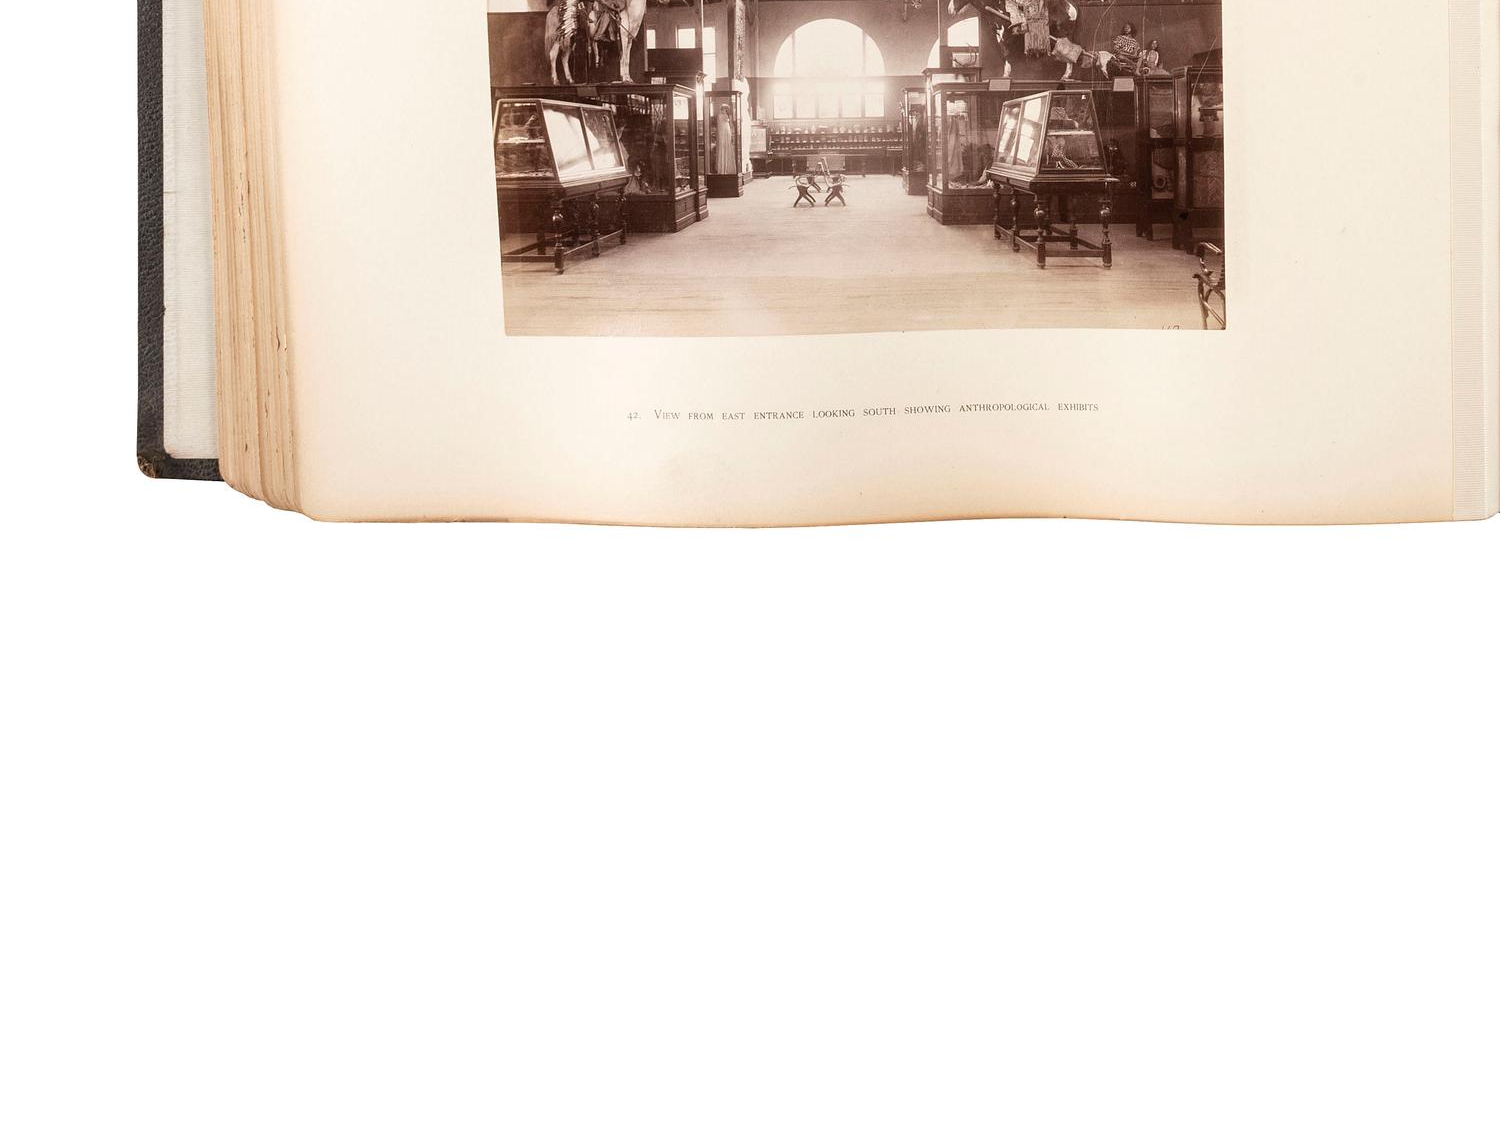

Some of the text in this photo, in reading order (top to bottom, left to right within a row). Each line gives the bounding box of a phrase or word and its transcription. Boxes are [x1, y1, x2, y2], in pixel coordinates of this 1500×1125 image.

[653, 408, 681, 420] VIEW
[688, 411, 714, 421] FROM
[721, 411, 746, 421] EAST
[753, 410, 805, 420] ENTRANCE
[812, 409, 856, 419] LOOKING
[862, 406, 897, 417] SOUTH
[903, 404, 952, 415] SHOWING
[958, 403, 1050, 413] ANTHROPOLOGICAL
[1057, 402, 1100, 412] EXHIBITS
